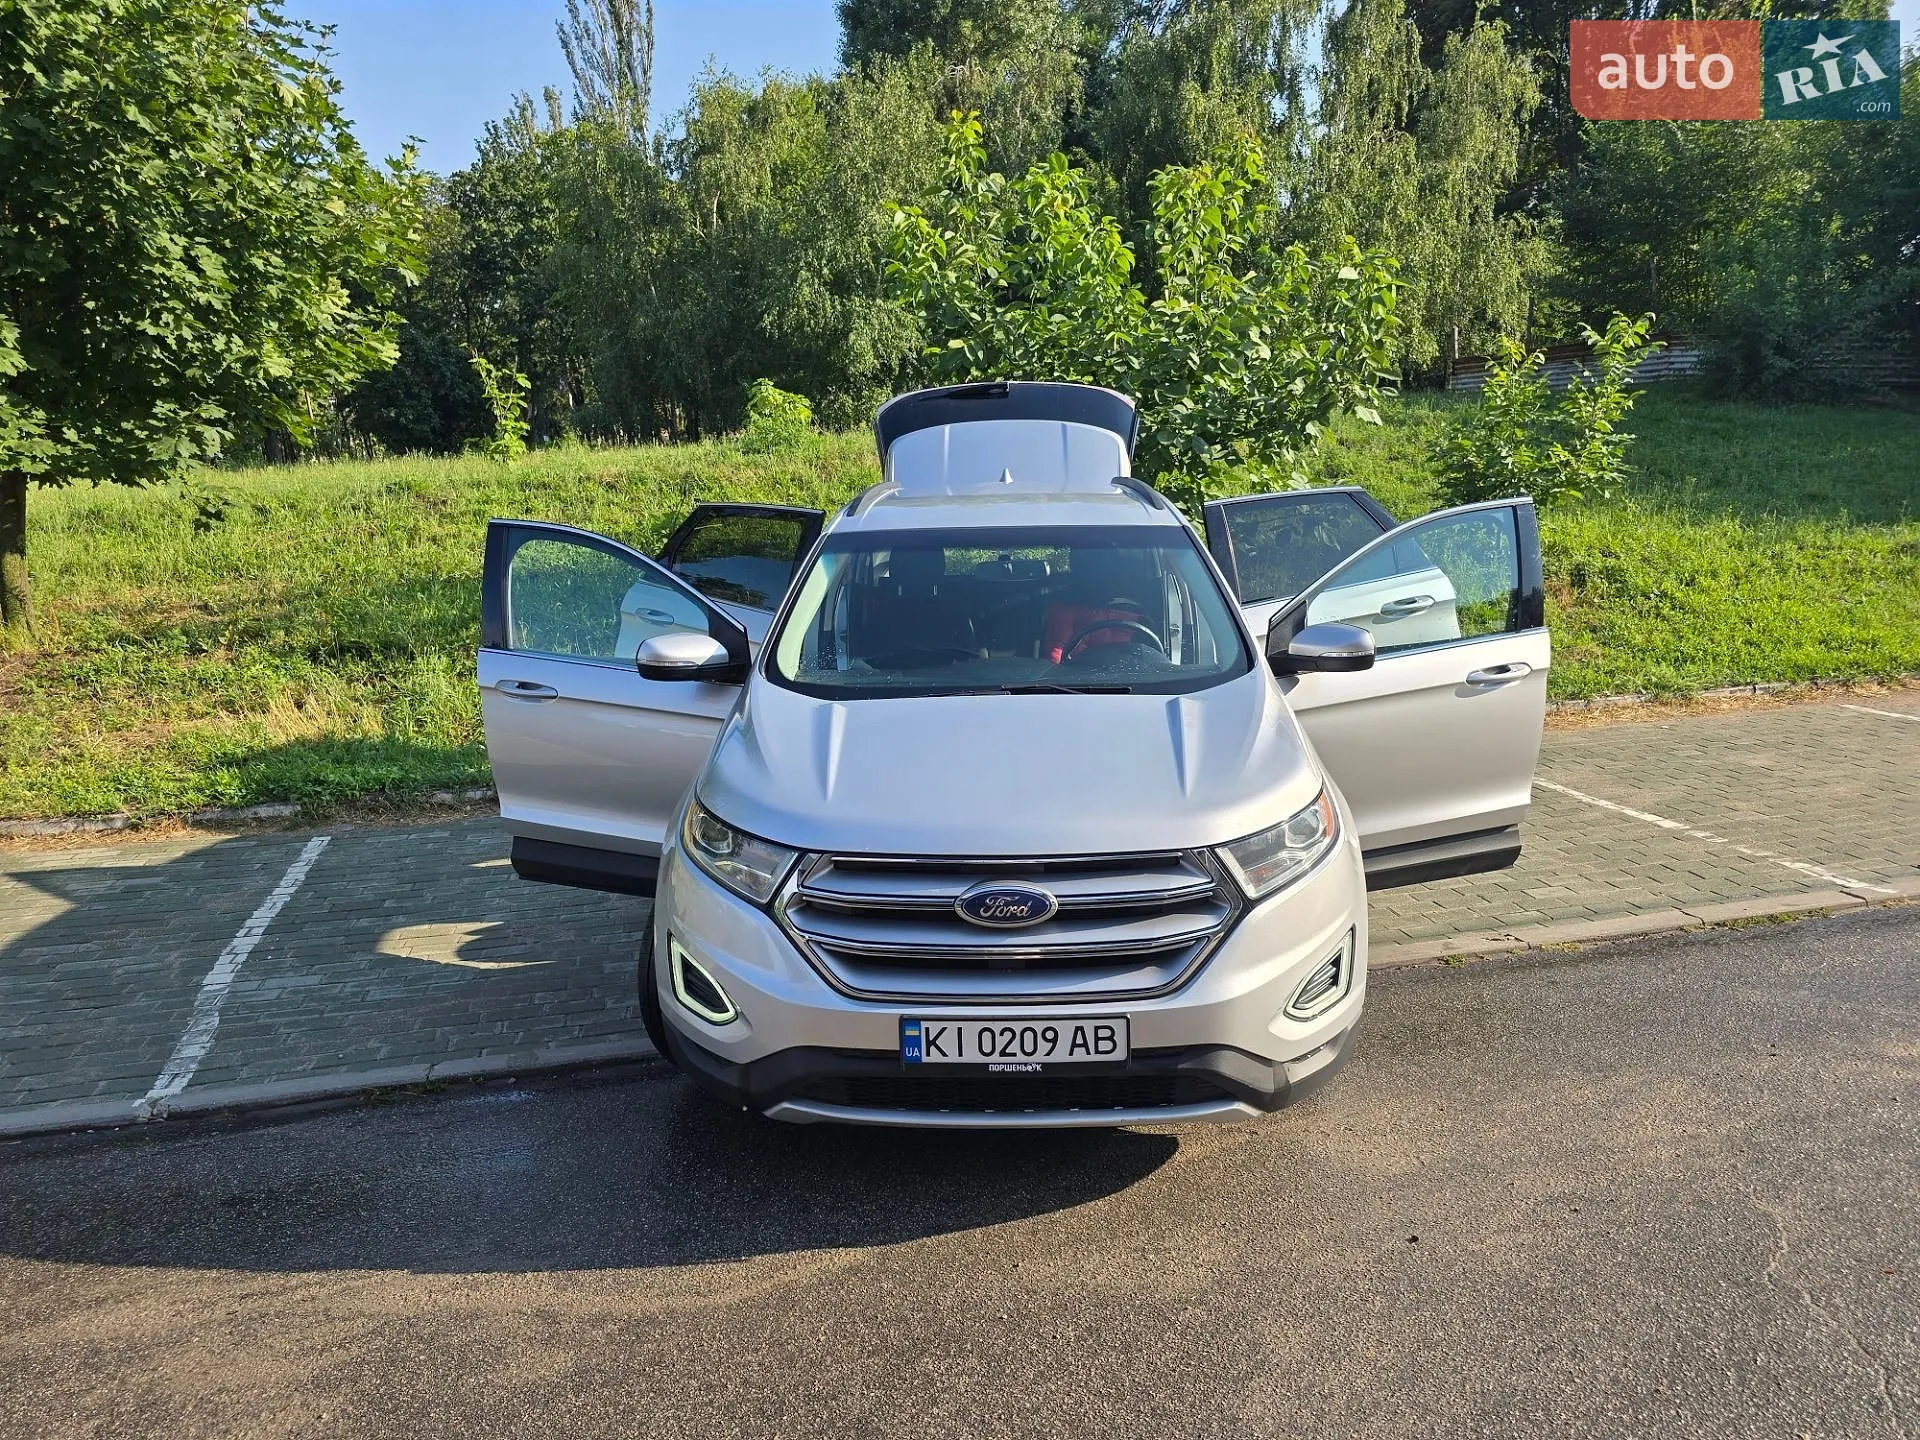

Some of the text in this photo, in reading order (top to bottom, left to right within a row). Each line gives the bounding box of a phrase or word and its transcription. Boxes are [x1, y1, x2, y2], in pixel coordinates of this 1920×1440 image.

[979, 895, 1032, 918] Ford
[905, 1047, 920, 1057] UA
[925, 1025, 1118, 1058] KI 0209 AB
